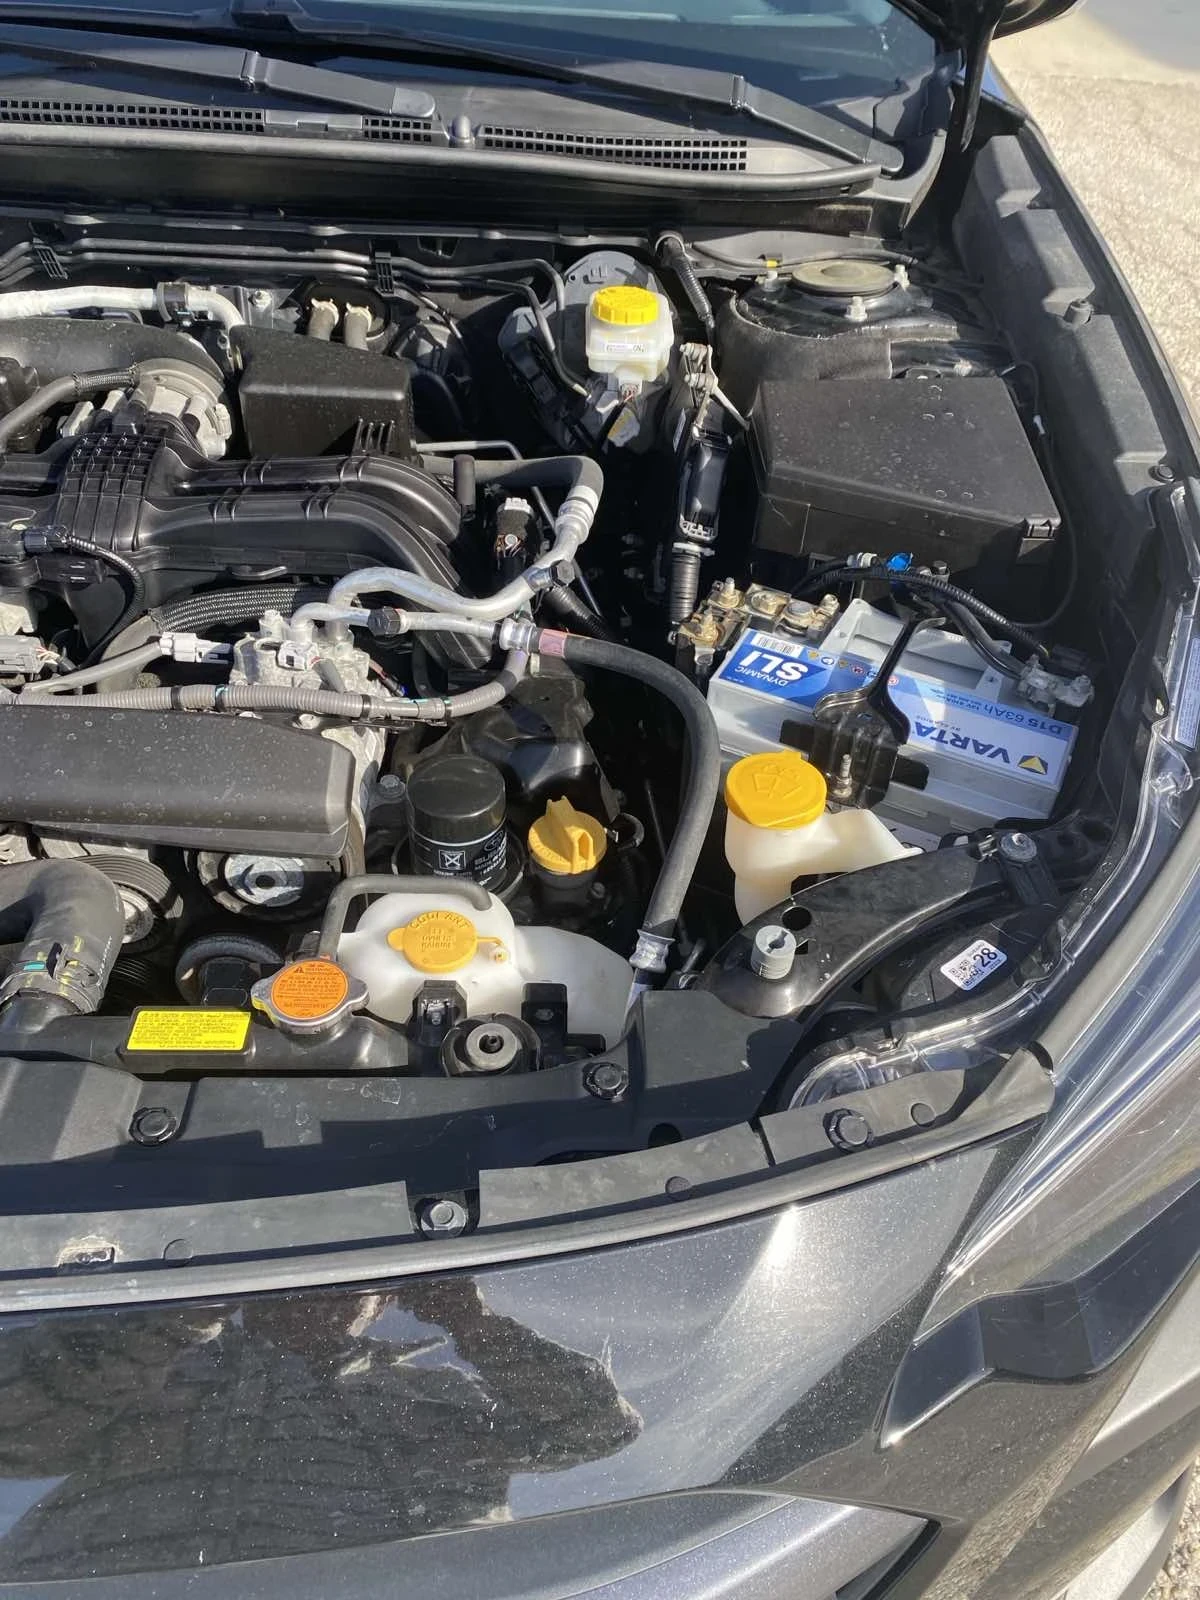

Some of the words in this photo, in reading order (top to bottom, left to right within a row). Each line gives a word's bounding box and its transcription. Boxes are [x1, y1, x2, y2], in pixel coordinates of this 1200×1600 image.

[735, 665, 790, 687] DYNAMIC
[739, 650, 809, 681] SLI
[984, 704, 1026, 724] 63Ah
[1028, 719, 1062, 735] D15
[914, 721, 1011, 764] VARTA
[973, 947, 998, 968] 28
